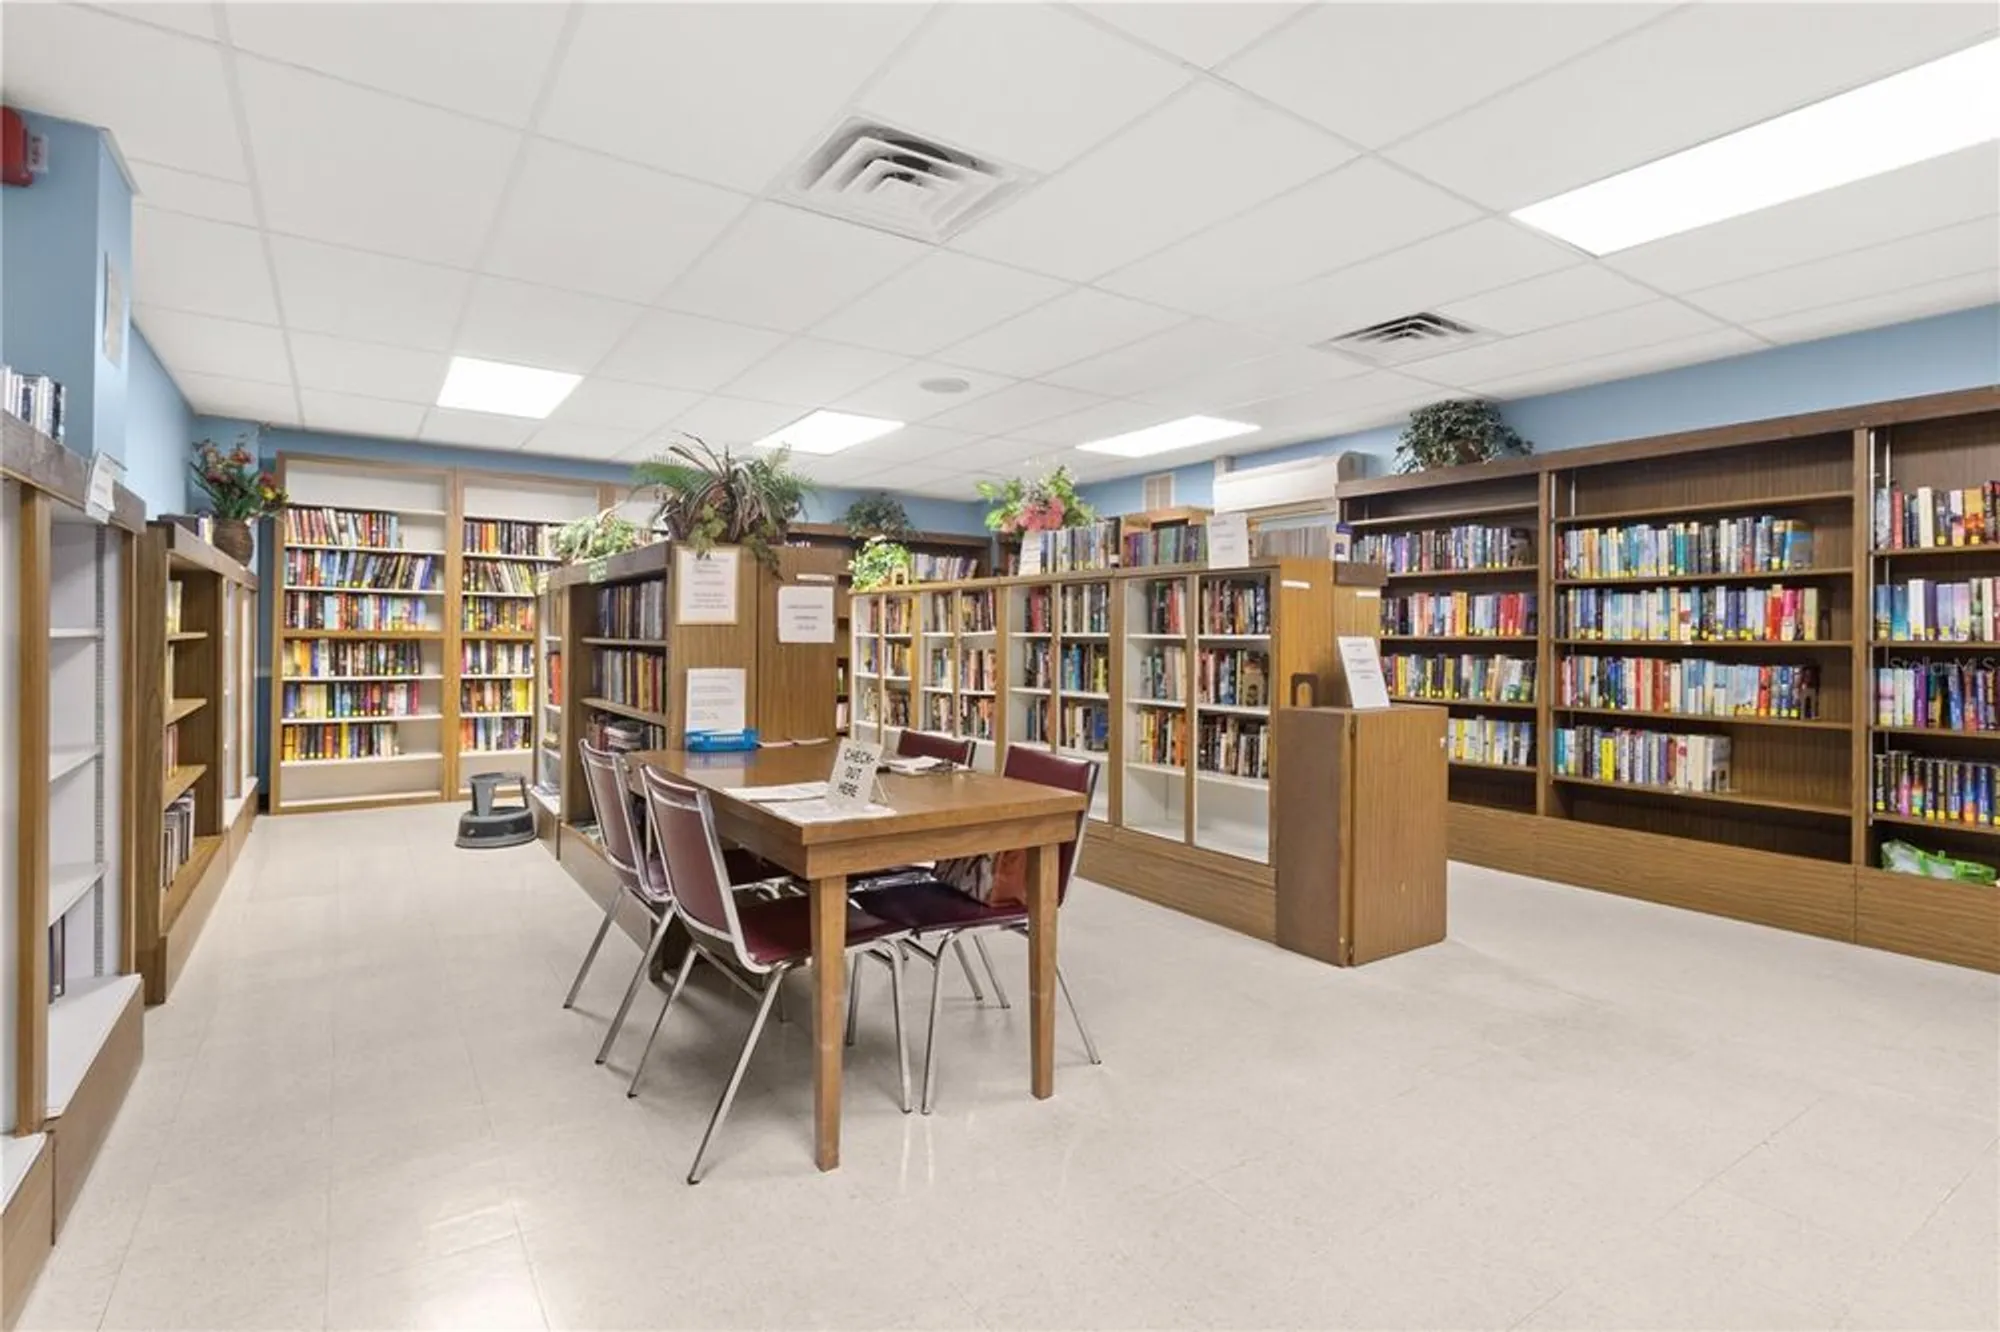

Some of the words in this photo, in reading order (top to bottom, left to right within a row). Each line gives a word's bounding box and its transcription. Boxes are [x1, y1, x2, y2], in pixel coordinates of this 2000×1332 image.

[844, 747, 875, 764] CHECK-
[845, 766, 863, 779] OUT
[839, 782, 859, 798] HERE
